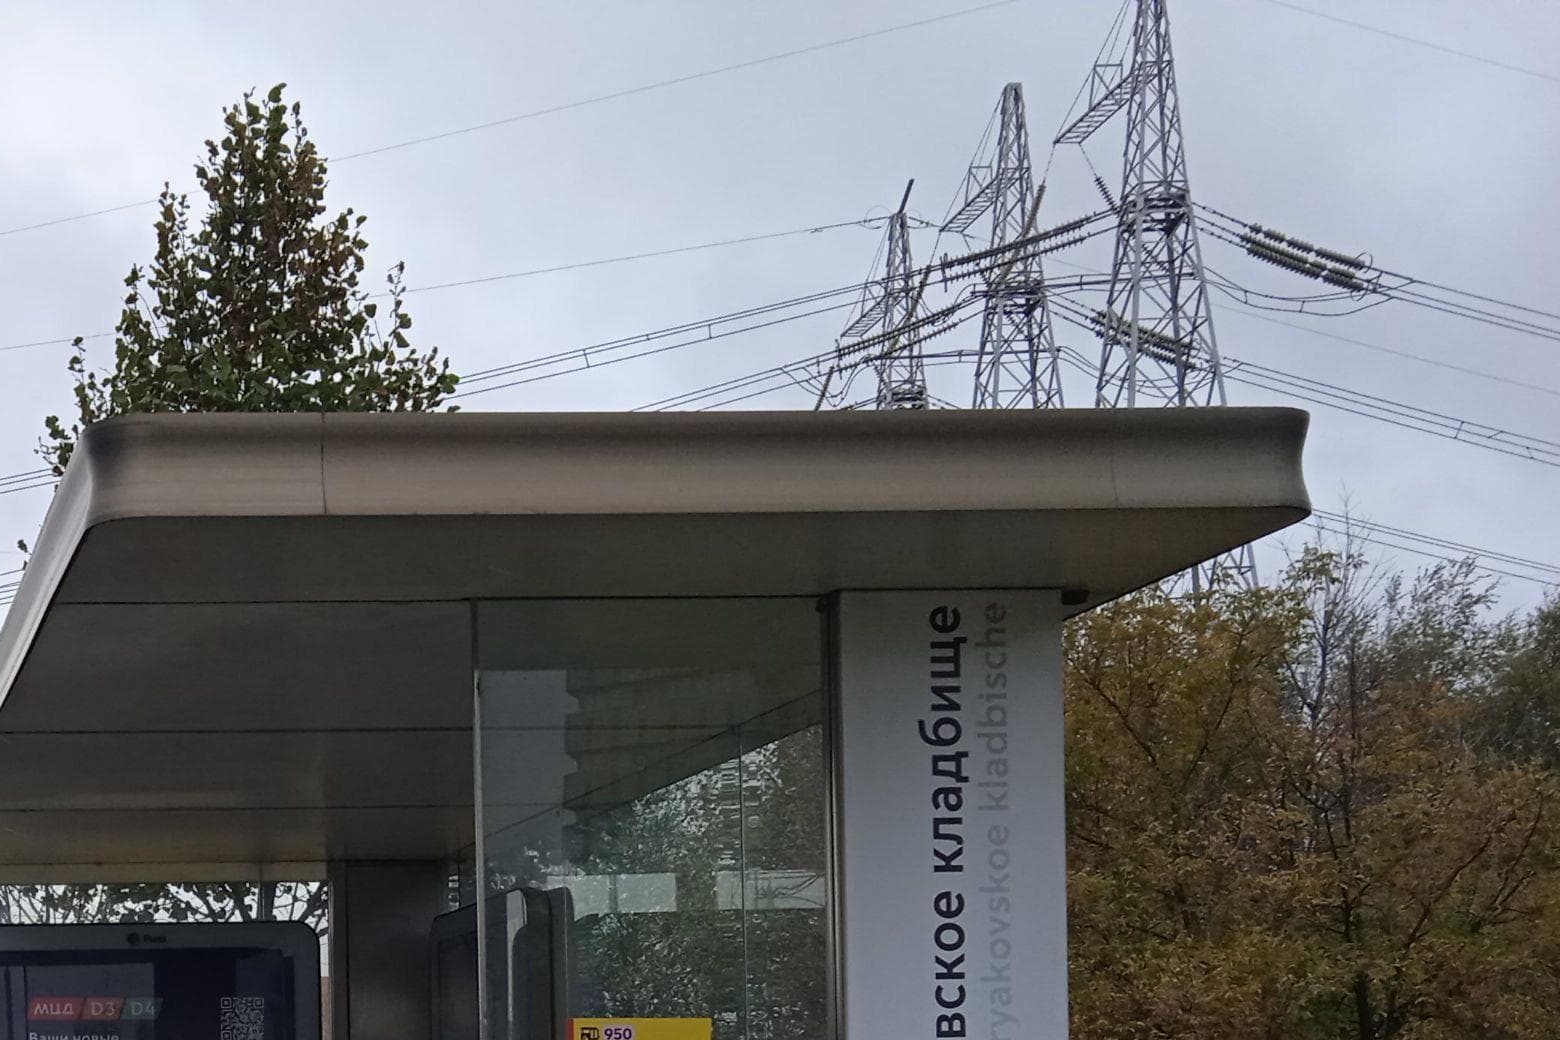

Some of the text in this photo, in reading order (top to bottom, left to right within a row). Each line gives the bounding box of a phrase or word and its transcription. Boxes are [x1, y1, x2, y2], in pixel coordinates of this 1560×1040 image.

[918, 605, 970, 873] кладбище
[975, 602, 1009, 811] kladbische
[33, 1002, 155, 1016] МЦД D3 D4
[604, 1028, 632, 1040] 950
